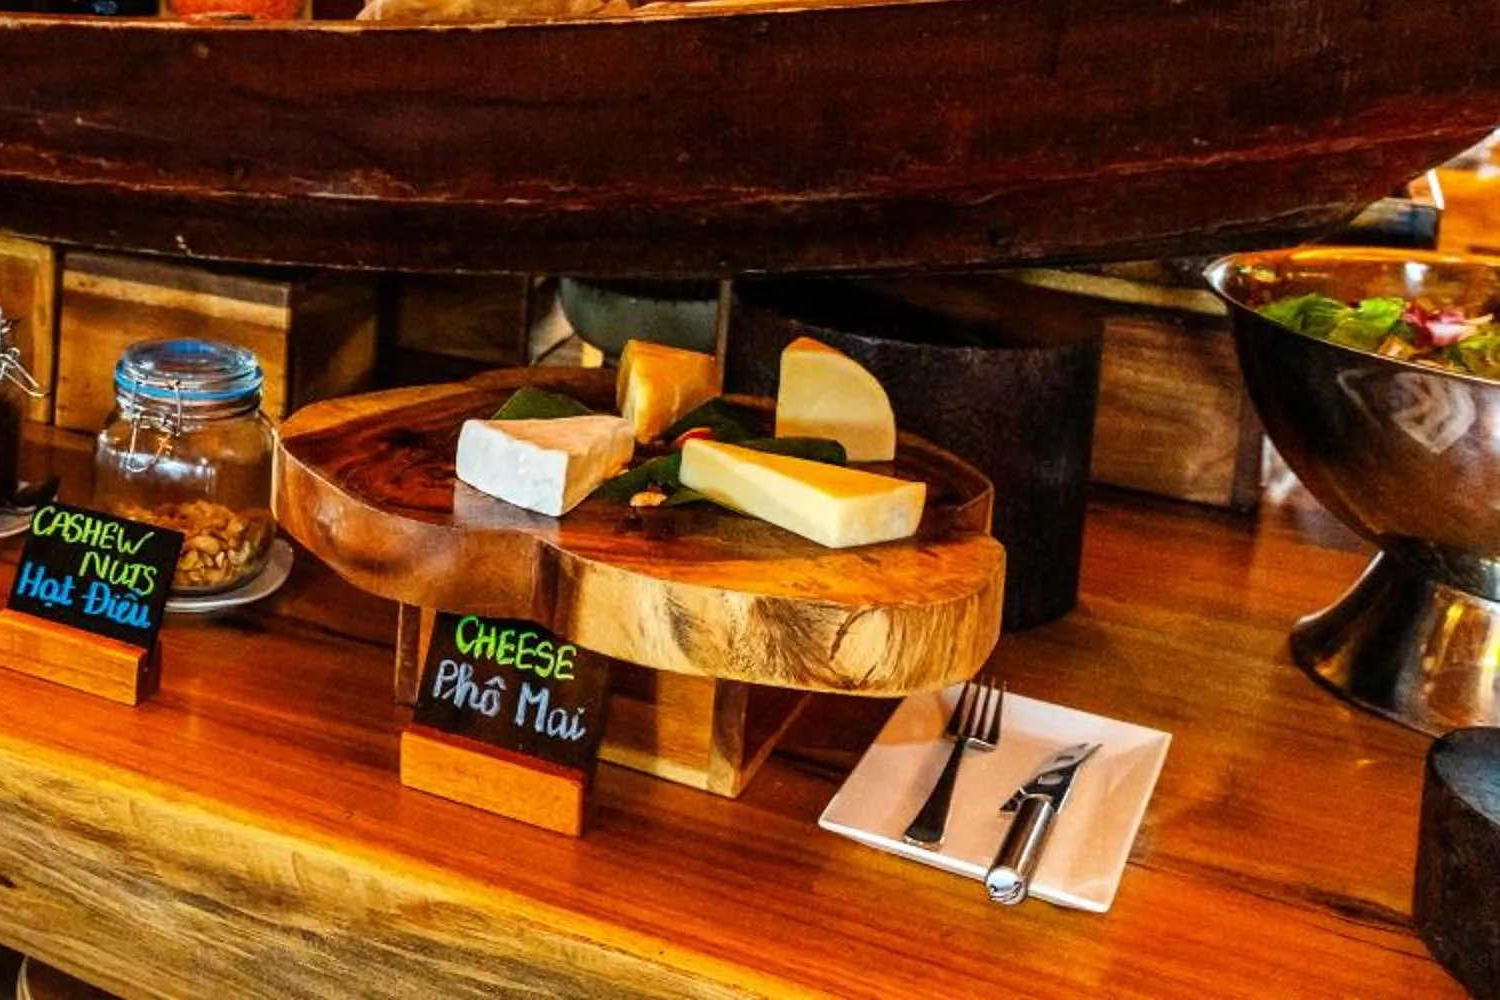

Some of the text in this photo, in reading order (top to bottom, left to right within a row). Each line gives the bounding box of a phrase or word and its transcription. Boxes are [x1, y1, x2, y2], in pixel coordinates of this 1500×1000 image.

[32, 506, 155, 555] CASHEW
[16, 560, 76, 608] Hạt
[78, 551, 157, 596] NUTS
[455, 616, 577, 681] CHEESE
[432, 659, 586, 741] Phô Mai
